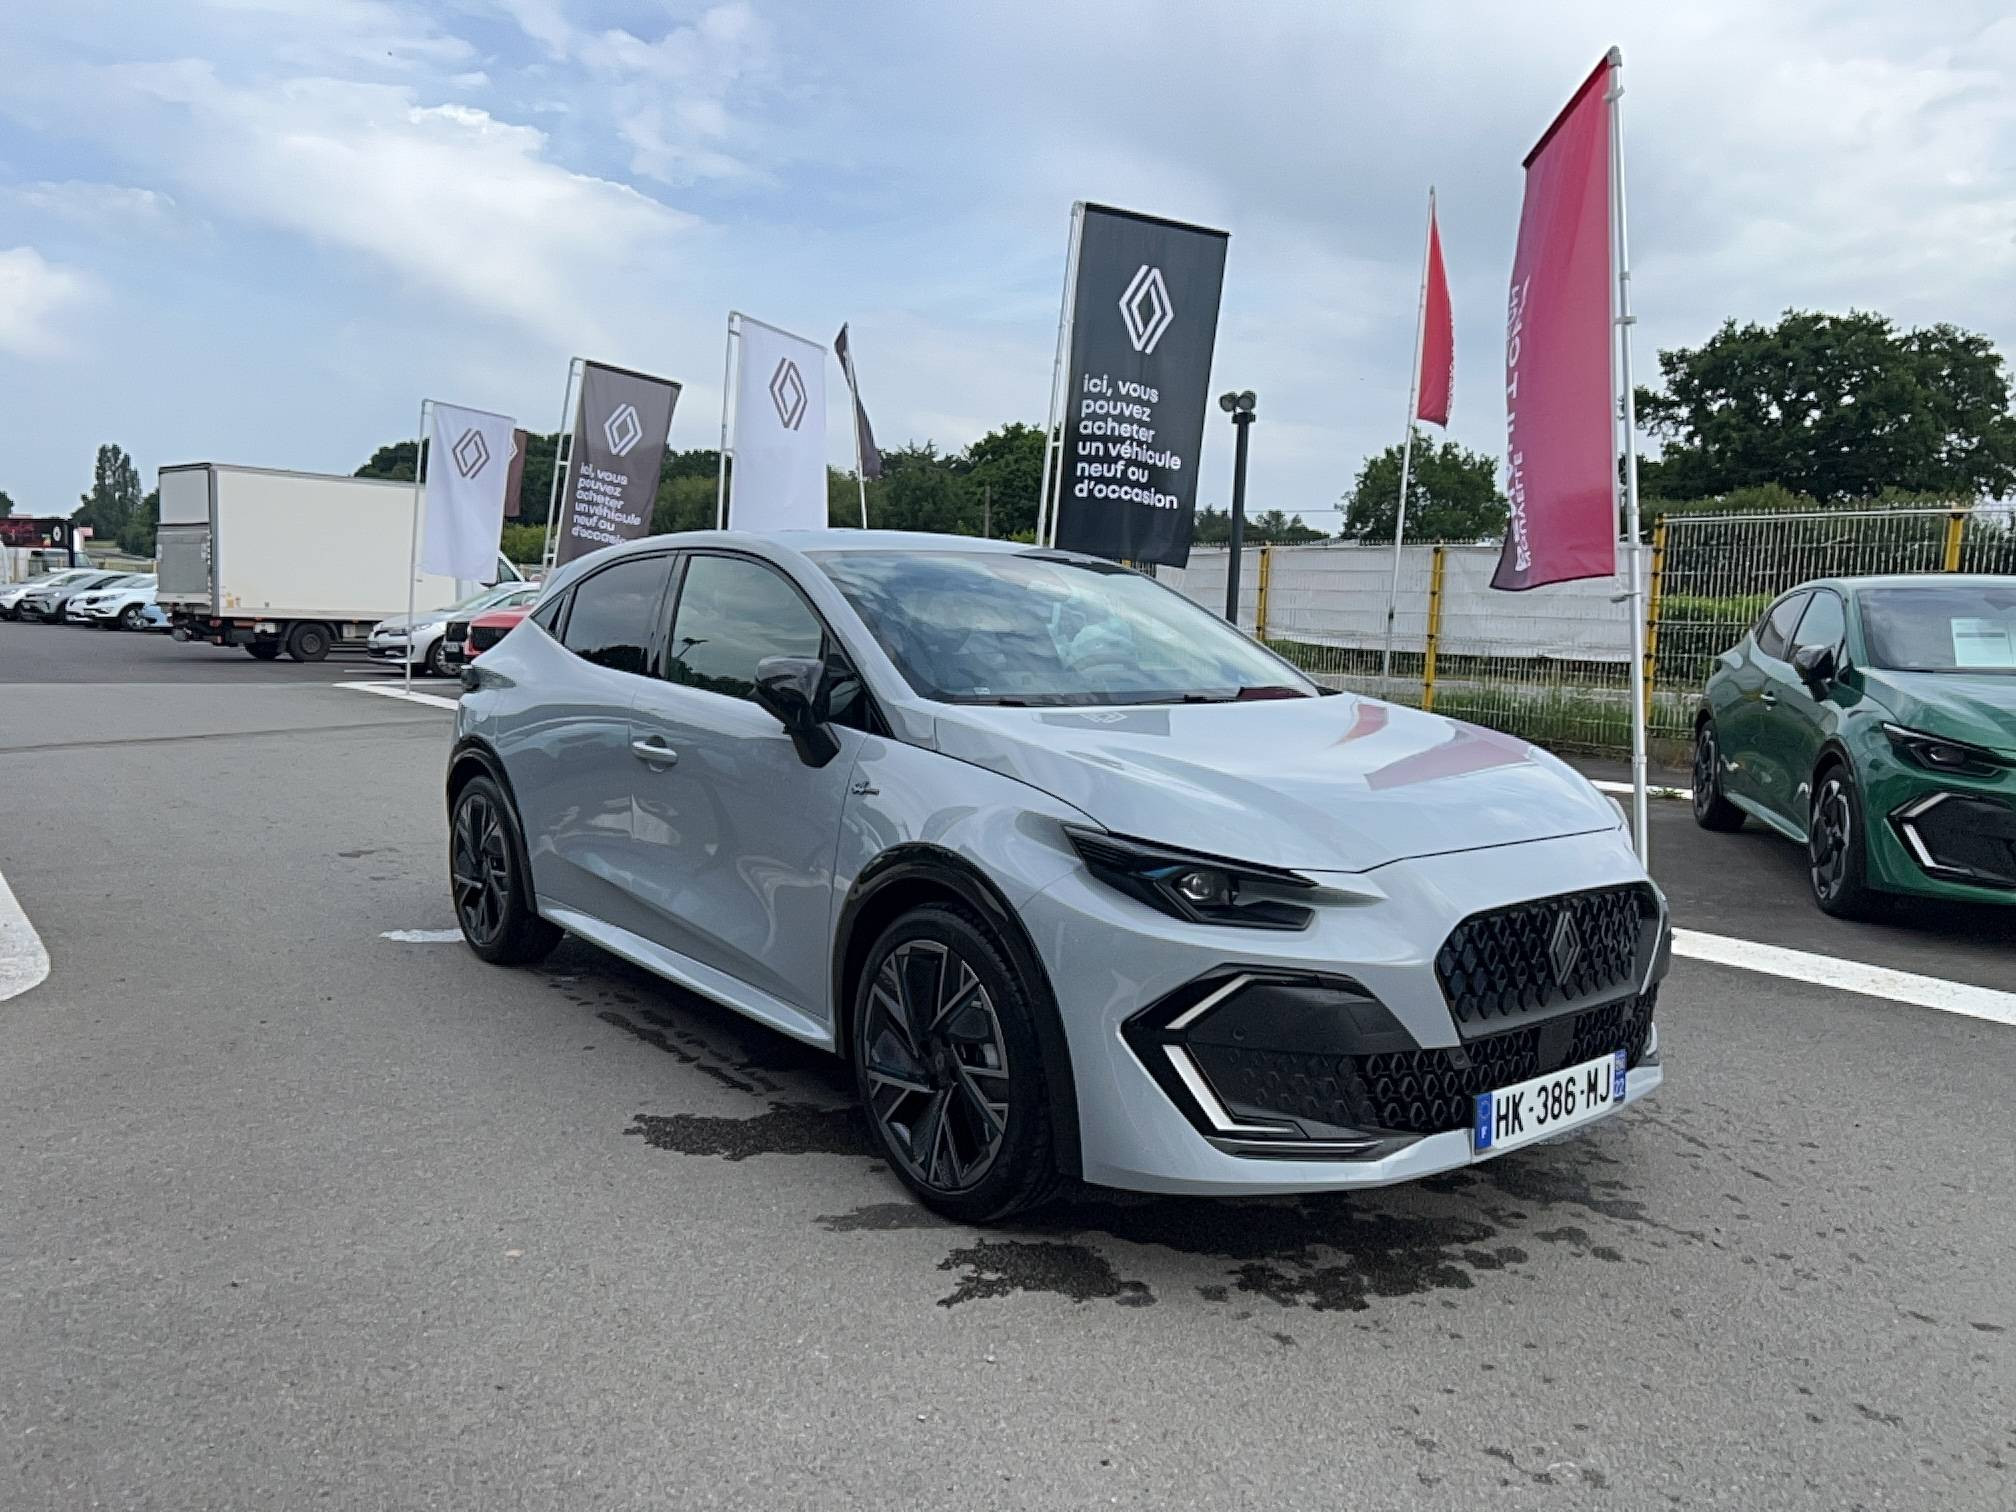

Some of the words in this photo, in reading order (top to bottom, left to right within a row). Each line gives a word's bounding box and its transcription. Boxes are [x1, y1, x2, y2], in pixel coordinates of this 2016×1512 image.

[1083, 373, 1113, 397] ici,
[1118, 380, 1160, 404] vous
[1081, 399, 1152, 421] pouvez
[1079, 417, 1156, 443] acheter
[1077, 440, 1104, 456] un
[1107, 440, 1182, 470] véhicule
[597, 469, 628, 485] vous
[1076, 460, 1126, 478] neuf
[1127, 465, 1149, 483] ou
[577, 477, 622, 497] pouvez
[1074, 479, 1178, 510] d'occasion
[576, 490, 624, 509] acheter
[573, 515, 599, 527] neuf
[598, 520, 616, 531] ou
[575, 502, 588, 512] un
[589, 504, 641, 525] véhicule
[1480, 1126, 1488, 1139] F
